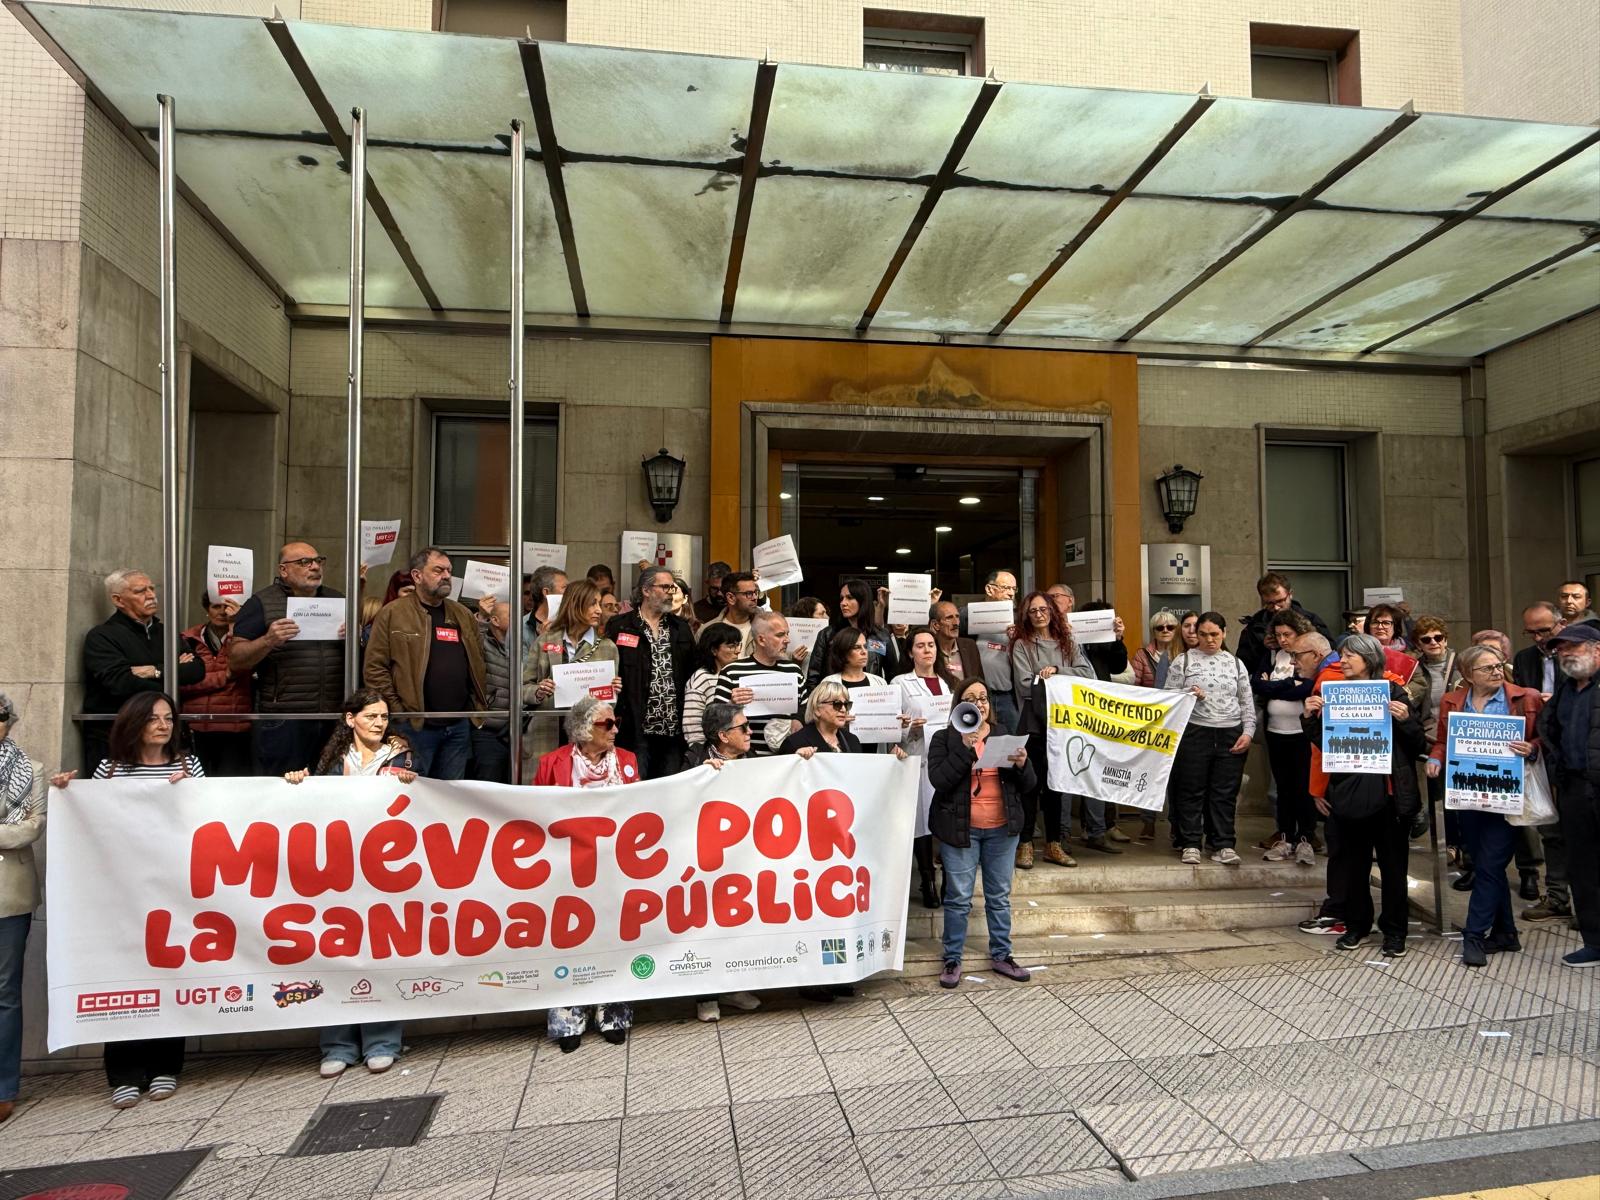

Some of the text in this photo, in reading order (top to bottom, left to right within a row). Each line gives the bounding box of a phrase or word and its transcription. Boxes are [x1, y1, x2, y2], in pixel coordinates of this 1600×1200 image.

[1328, 687, 1339, 695] LO
[1340, 686, 1372, 695] PRIMERO
[1080, 689, 1163, 721] YO DEFIENDO
[1324, 693, 1389, 704] LA PRIMARIA
[1055, 708, 1071, 725] LA
[1075, 712, 1125, 739] SANIDAD
[1456, 719, 1517, 731] LO PRIMERO ES
[1450, 726, 1521, 740] LA PRIMARIA
[697, 791, 855, 872] POR
[669, 960, 712, 971] CAVASTUR
[725, 955, 798, 968] consumidor.es
[412, 981, 442, 994] APG
[82, 994, 133, 1009] CCOO
[176, 987, 221, 1005] UGT
[218, 1005, 254, 1014] Asturias
